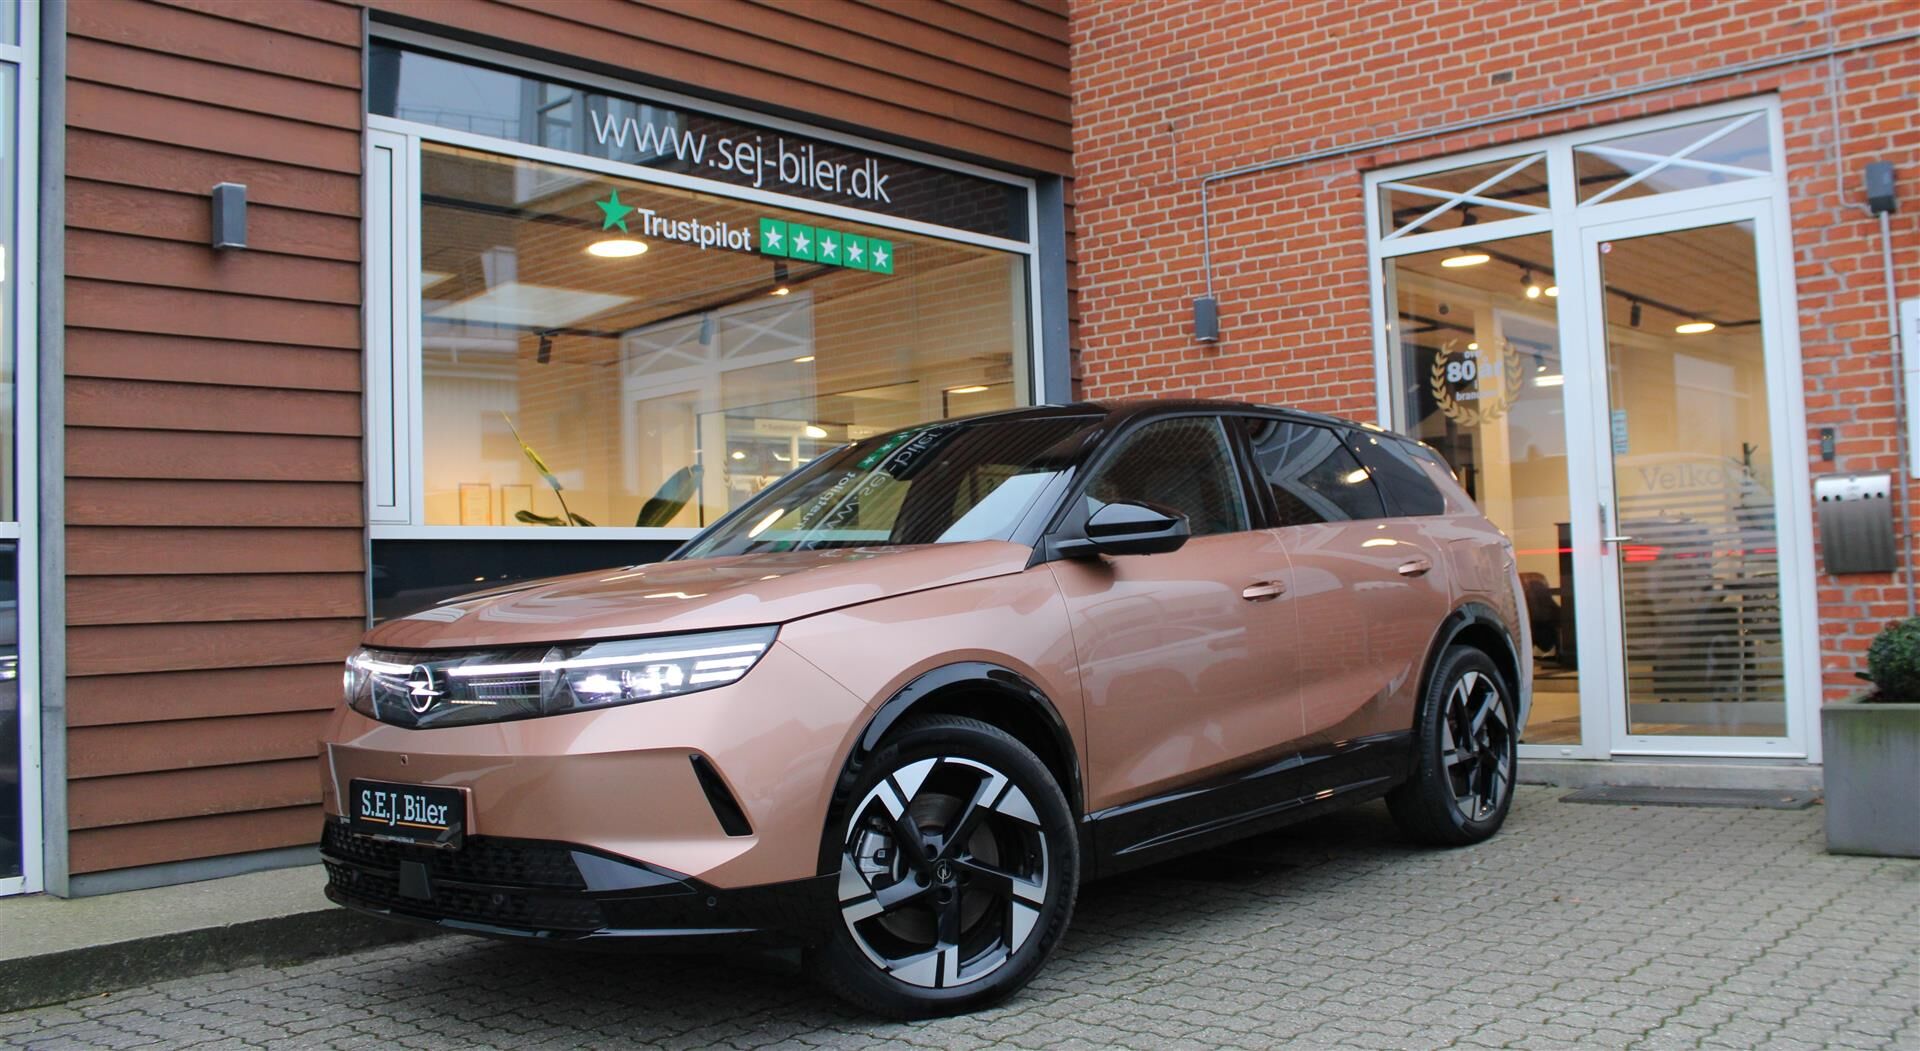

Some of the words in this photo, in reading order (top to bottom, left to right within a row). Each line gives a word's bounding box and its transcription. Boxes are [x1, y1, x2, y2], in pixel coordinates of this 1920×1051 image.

[591, 109, 891, 203] www.sej-biler.dk
[637, 208, 752, 251] Trustpilot
[1447, 360, 1476, 382] 80
[1456, 390, 1499, 401] bran
[1638, 463, 1735, 491] Velko
[361, 789, 401, 826] S.E.J.
[403, 794, 448, 825] Biler
